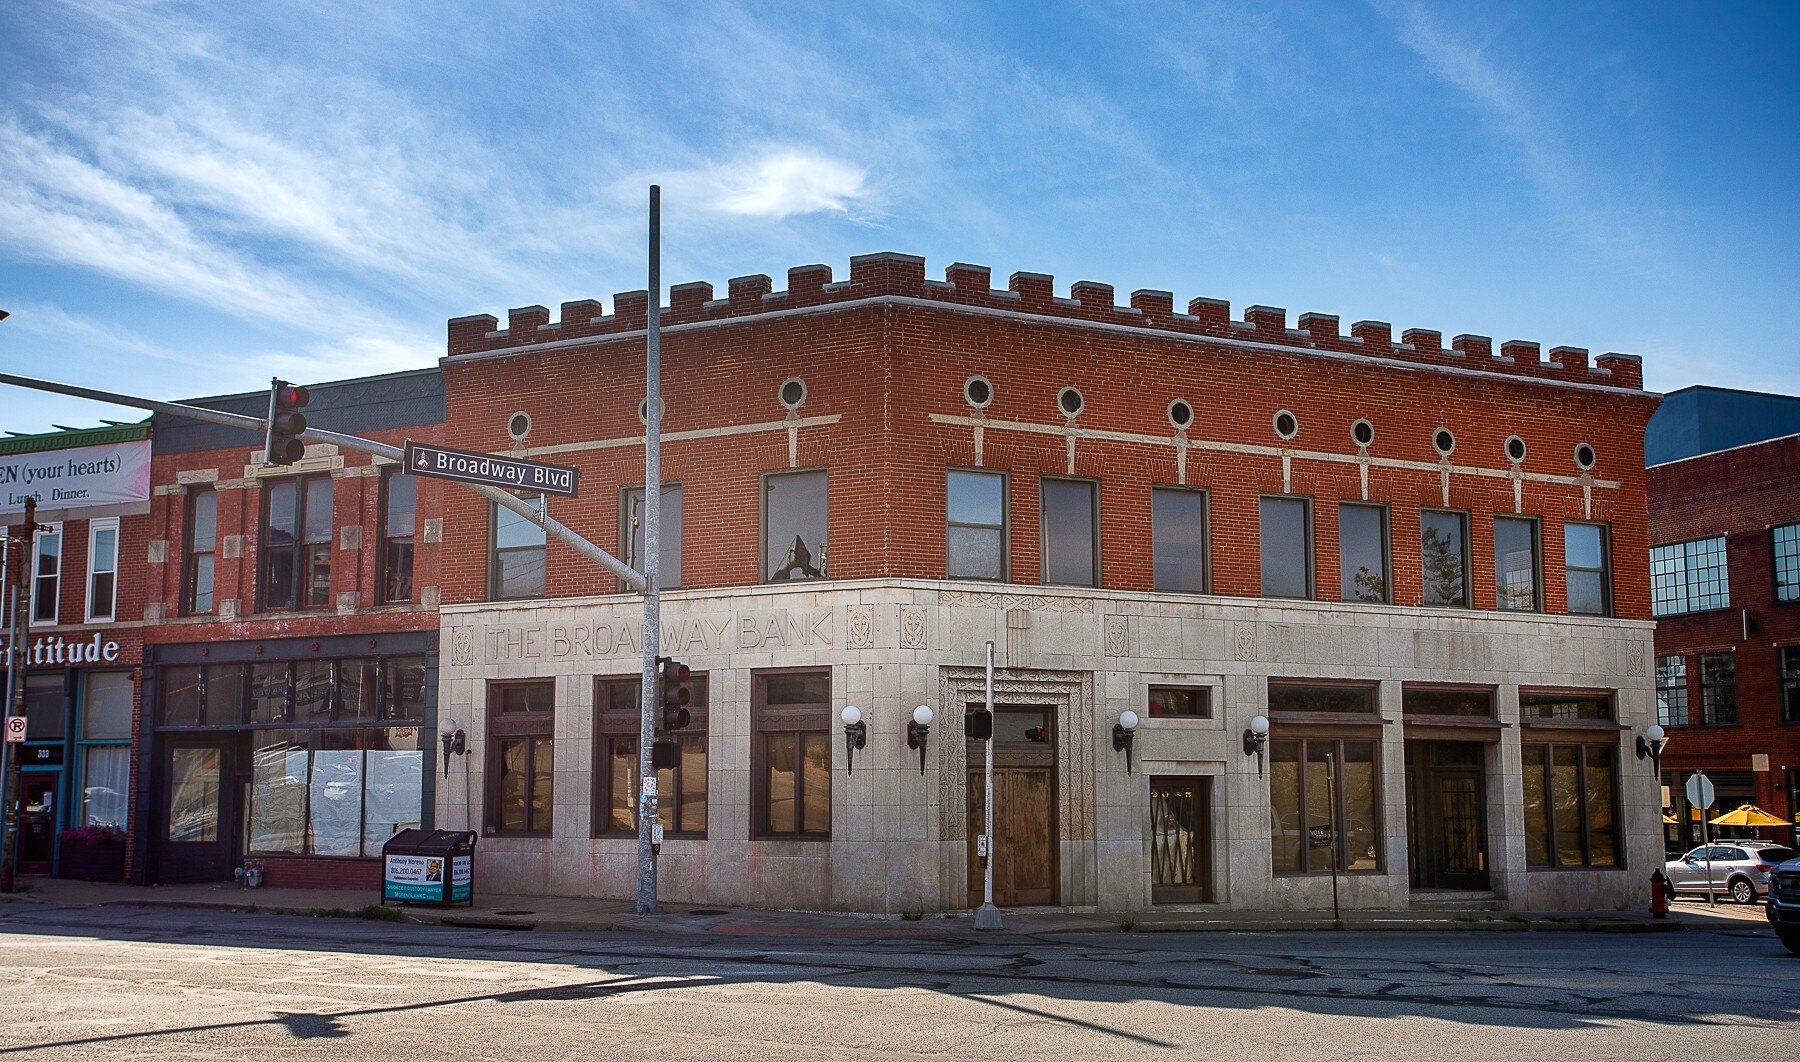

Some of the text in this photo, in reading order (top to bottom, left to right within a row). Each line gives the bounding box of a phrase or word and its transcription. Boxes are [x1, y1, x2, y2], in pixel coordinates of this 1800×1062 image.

[23, 463, 64, 484] (your
[68, 453, 122, 475] hearts)
[436, 452, 570, 488] Broadway Blvd
[52, 488, 90, 501] Dinner.
[488, 611, 832, 660] THE BROAWAY BANK
[390, 857, 407, 866] Anthony
